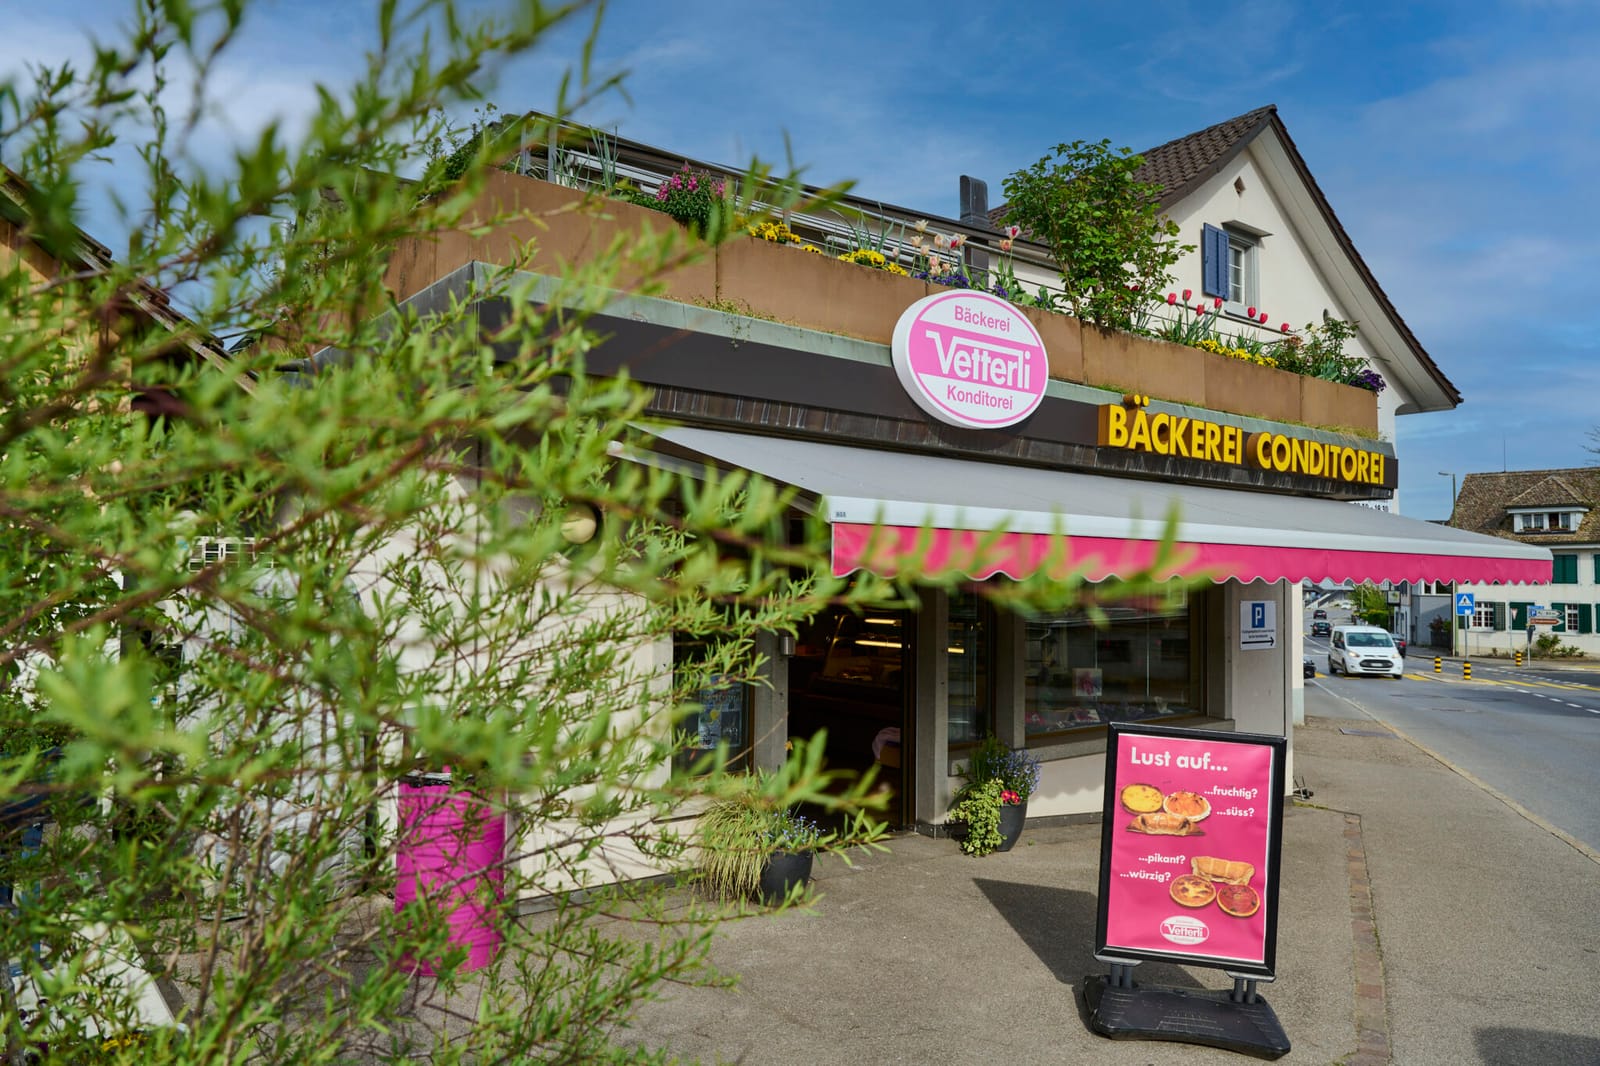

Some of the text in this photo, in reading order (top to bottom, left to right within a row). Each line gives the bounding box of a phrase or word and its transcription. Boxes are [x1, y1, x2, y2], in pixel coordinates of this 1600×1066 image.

[954, 305, 1010, 332] Bäckerei
[925, 329, 1031, 390] Vetterli
[947, 384, 1013, 410] Konditorei
[1108, 394, 1385, 485] BÄCKEREI CONDITOREI
[1255, 606, 1263, 626] P
[1131, 746, 1228, 772] Lust auf...
[1204, 785, 1258, 799] ...fruchtig?
[1216, 806, 1255, 817] ...süss?
[1138, 854, 1186, 866] ...pikant?
[1119, 870, 1172, 883] ...würzig?
[1164, 923, 1203, 938] Vetterli
